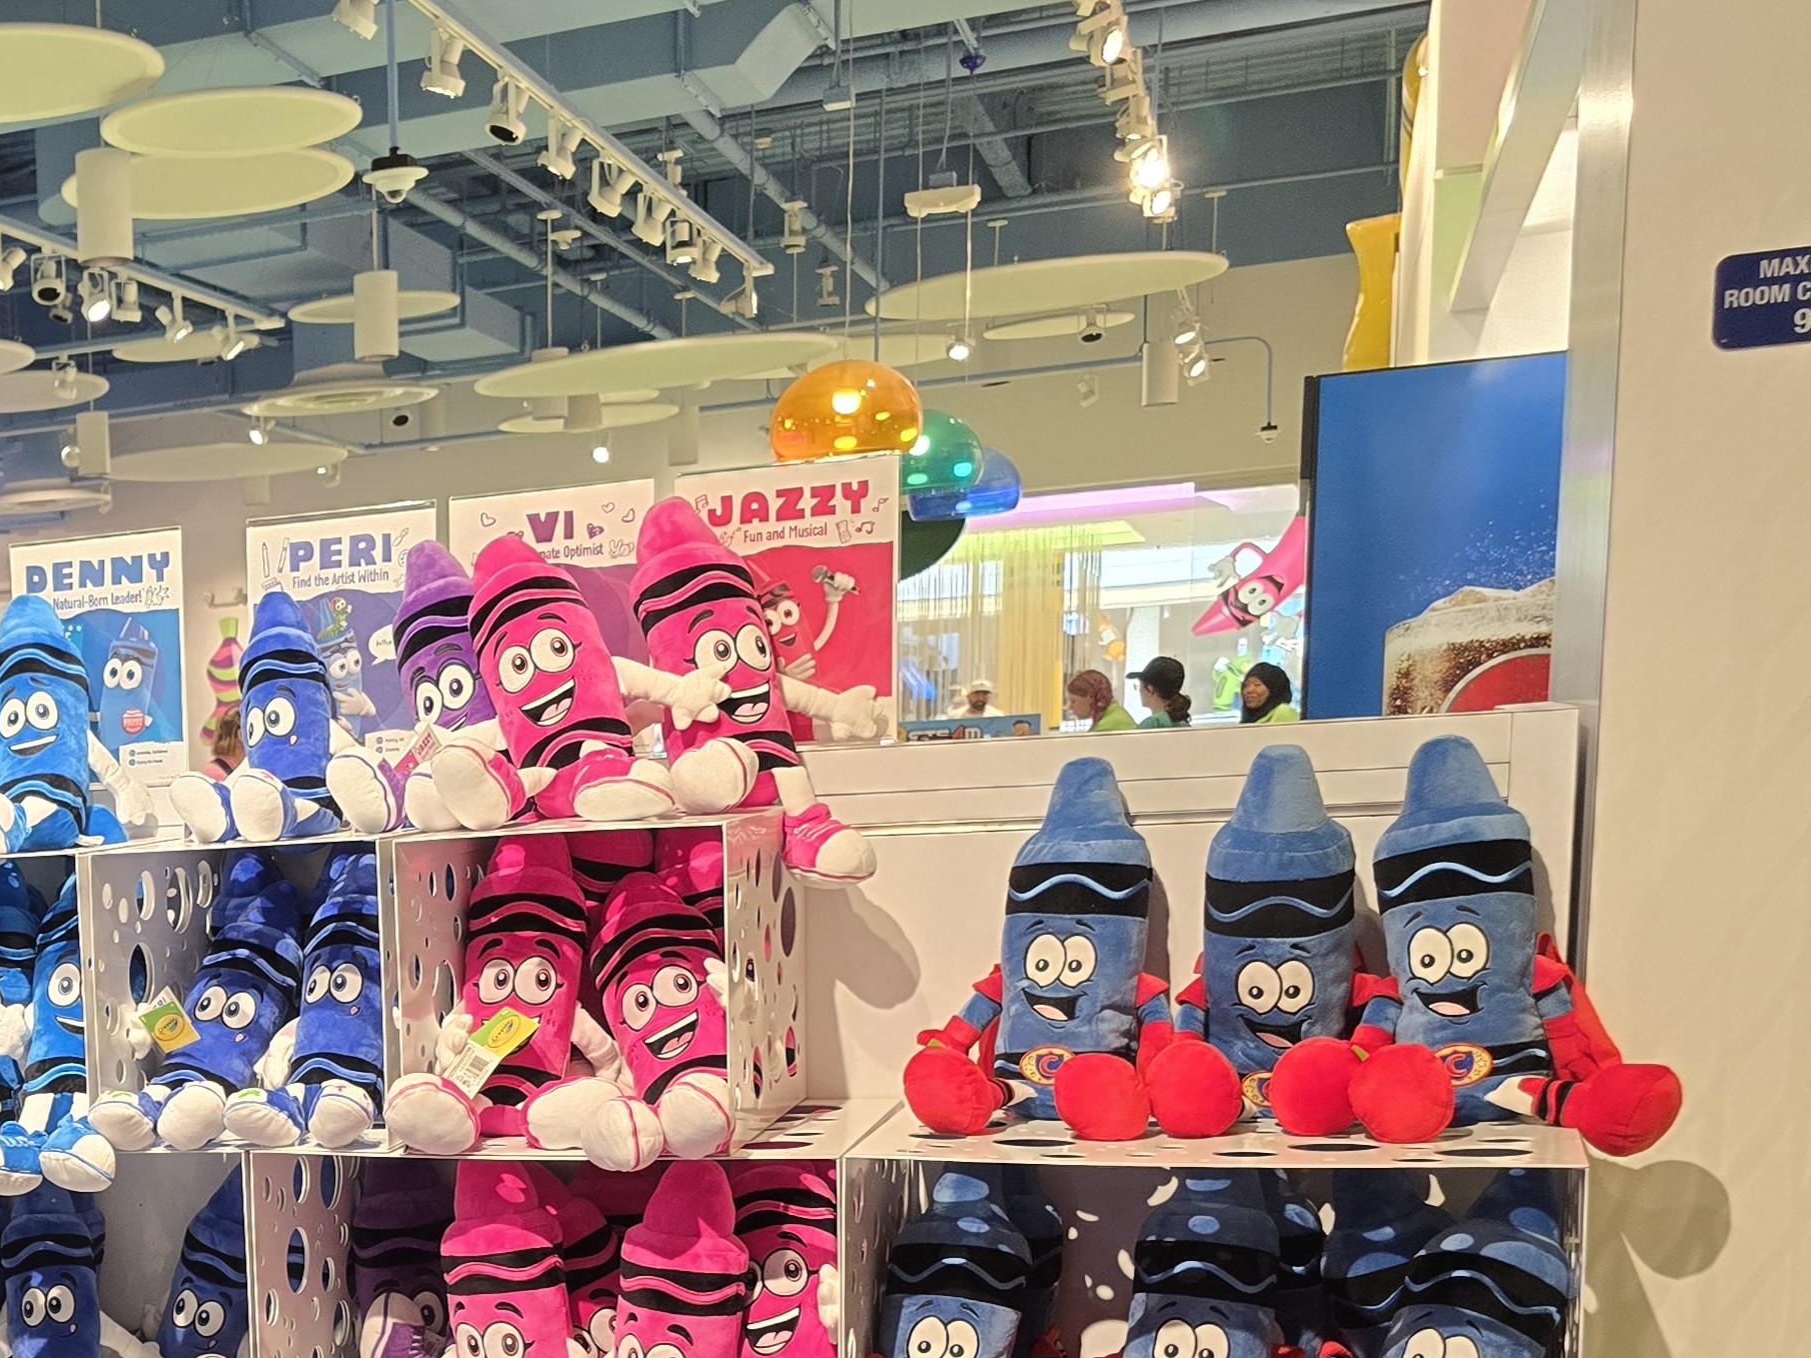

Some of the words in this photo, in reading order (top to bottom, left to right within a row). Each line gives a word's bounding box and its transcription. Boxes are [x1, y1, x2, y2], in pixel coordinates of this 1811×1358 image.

[1759, 254, 1811, 279] MAX
[1723, 284, 1791, 309] ROOM
[1796, 280, 1811, 301] C
[706, 479, 869, 528] JAZZY
[526, 510, 574, 544] VI
[744, 529, 763, 543] Fun
[765, 526, 785, 541] and
[788, 522, 828, 539] Musical
[289, 532, 392, 573] PERI
[563, 543, 604, 560] Optimist
[25, 550, 170, 594] DENNY
[292, 575, 312, 589] Find
[314, 575, 329, 587] the
[331, 572, 356, 586] Artist
[358, 569, 390, 583] Within
[52, 595, 108, 611] Natural-Born
[110, 591, 142, 607] Leader!
